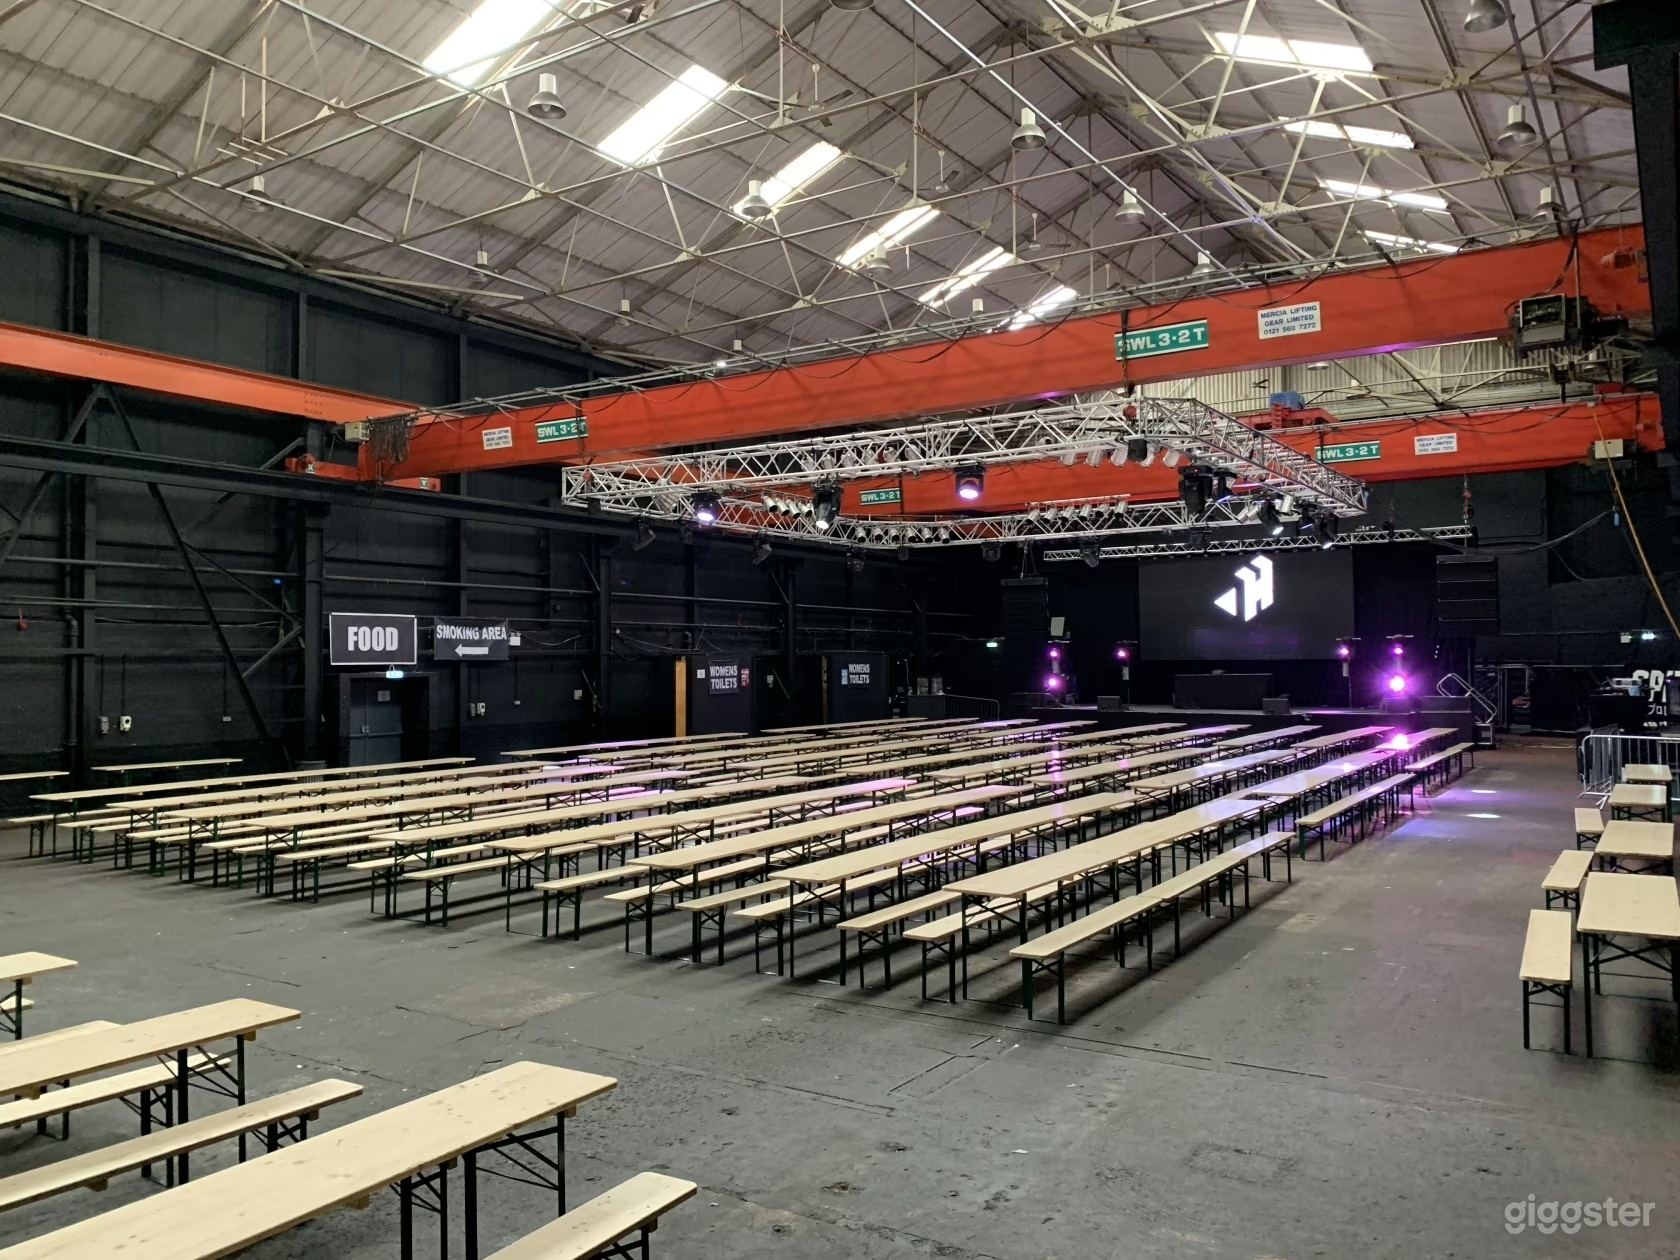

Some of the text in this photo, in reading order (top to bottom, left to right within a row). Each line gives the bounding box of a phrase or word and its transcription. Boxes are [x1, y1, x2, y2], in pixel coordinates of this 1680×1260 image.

[1260, 305, 1317, 319] MERCIA LIFTING
[1264, 314, 1315, 327] GEAR LIMITED
[1193, 326, 1205, 341] T
[1264, 327, 1280, 336] 0121
[1299, 322, 1316, 330] 7272
[537, 426, 560, 438] SWL
[1317, 448, 1344, 460] SWL
[1370, 445, 1379, 455] T
[861, 493, 880, 502] SWL
[347, 626, 399, 652] FOOD
[436, 624, 508, 641] SMOKING AREA
[709, 665, 738, 677] WOMENS
[848, 664, 870, 673] WOMENS
[710, 677, 738, 690] TOILETS
[849, 674, 870, 684] TOILETS
